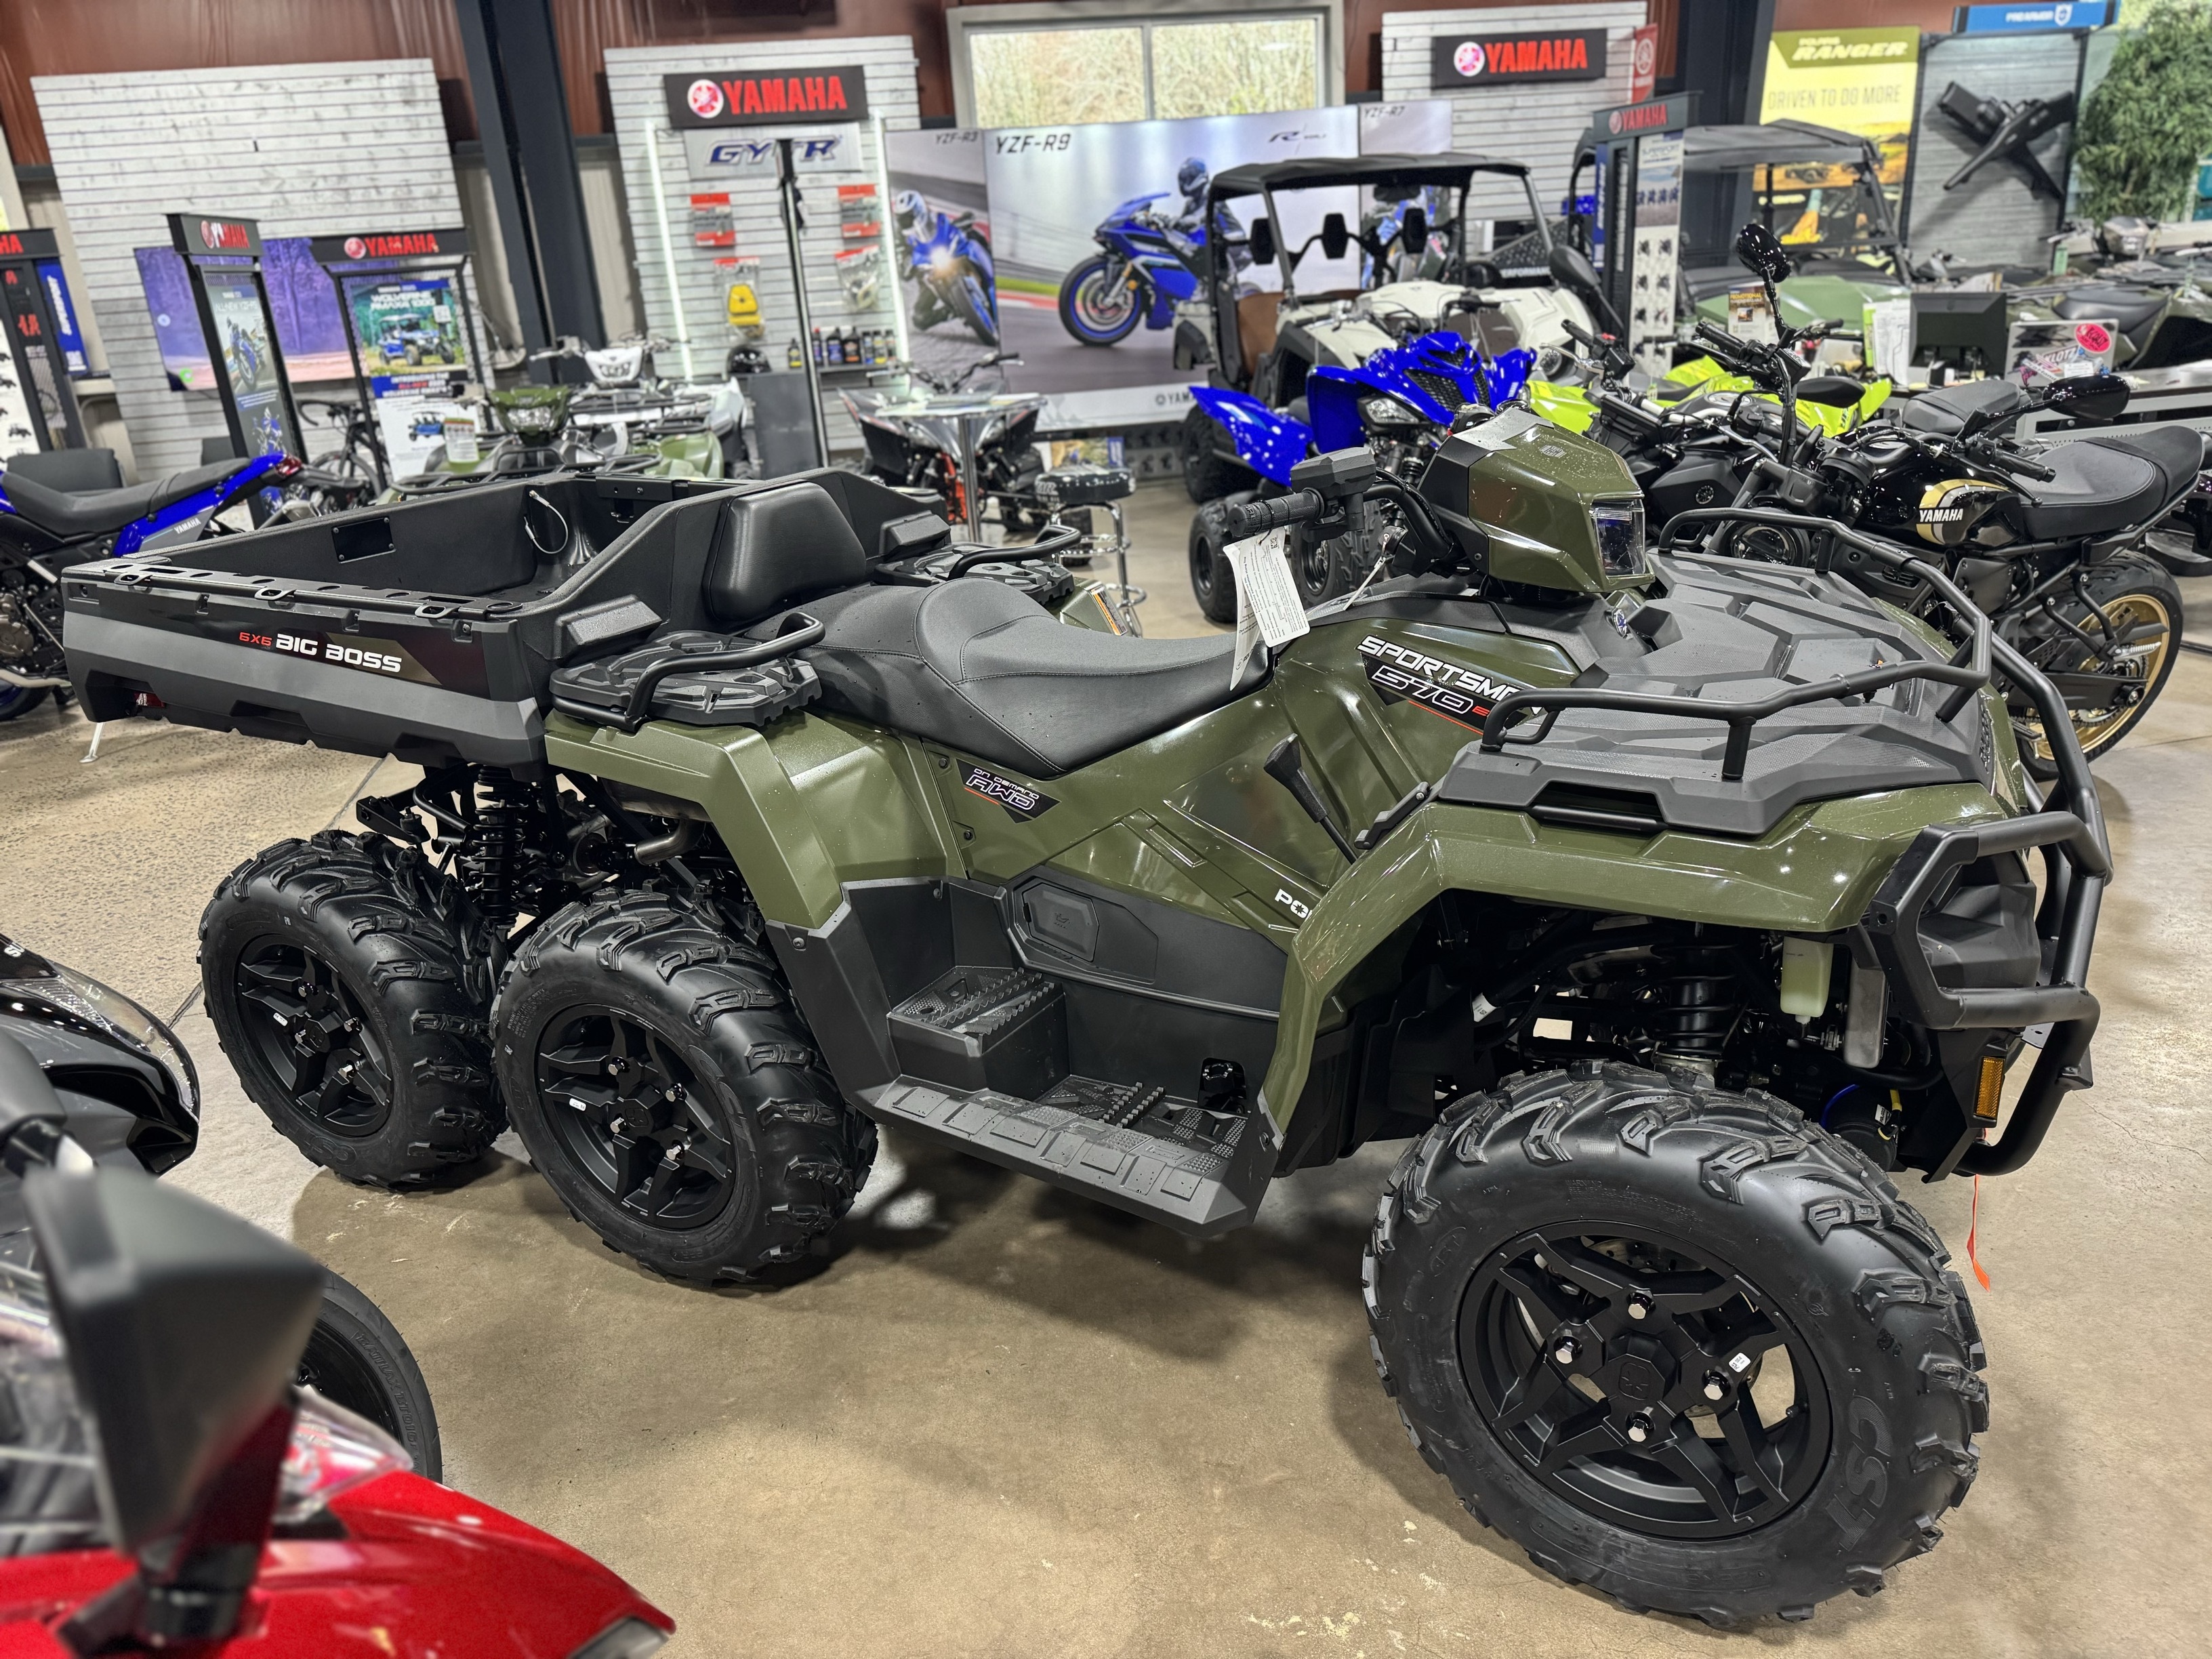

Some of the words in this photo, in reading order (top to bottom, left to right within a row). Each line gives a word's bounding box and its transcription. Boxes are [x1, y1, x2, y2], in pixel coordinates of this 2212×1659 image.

[1484, 39, 1588, 73] YAMAHA
[1792, 41, 1908, 61] RANGER
[722, 75, 848, 115] YAMAHA
[1768, 89, 1817, 110] DRIVEN
[1821, 88, 1837, 106] TO
[1840, 87, 1859, 106] DO
[1863, 84, 1902, 105] MORE
[1364, 106, 1406, 119] YZF-R7
[1622, 104, 1667, 131] YAMAHA
[996, 134, 1071, 155] YZF-R9
[364, 232, 440, 258] YAMAHA
[173, 517, 201, 534] YAMAHA
[1919, 508, 1964, 523] YAMAHA
[239, 632, 272, 647] 6X6
[276, 634, 318, 656] BIG
[325, 644, 402, 673] BOSS
[1372, 665, 1474, 714] 570
[966, 774, 1036, 811] AWD
[1825, 1395, 1892, 1551] CST
